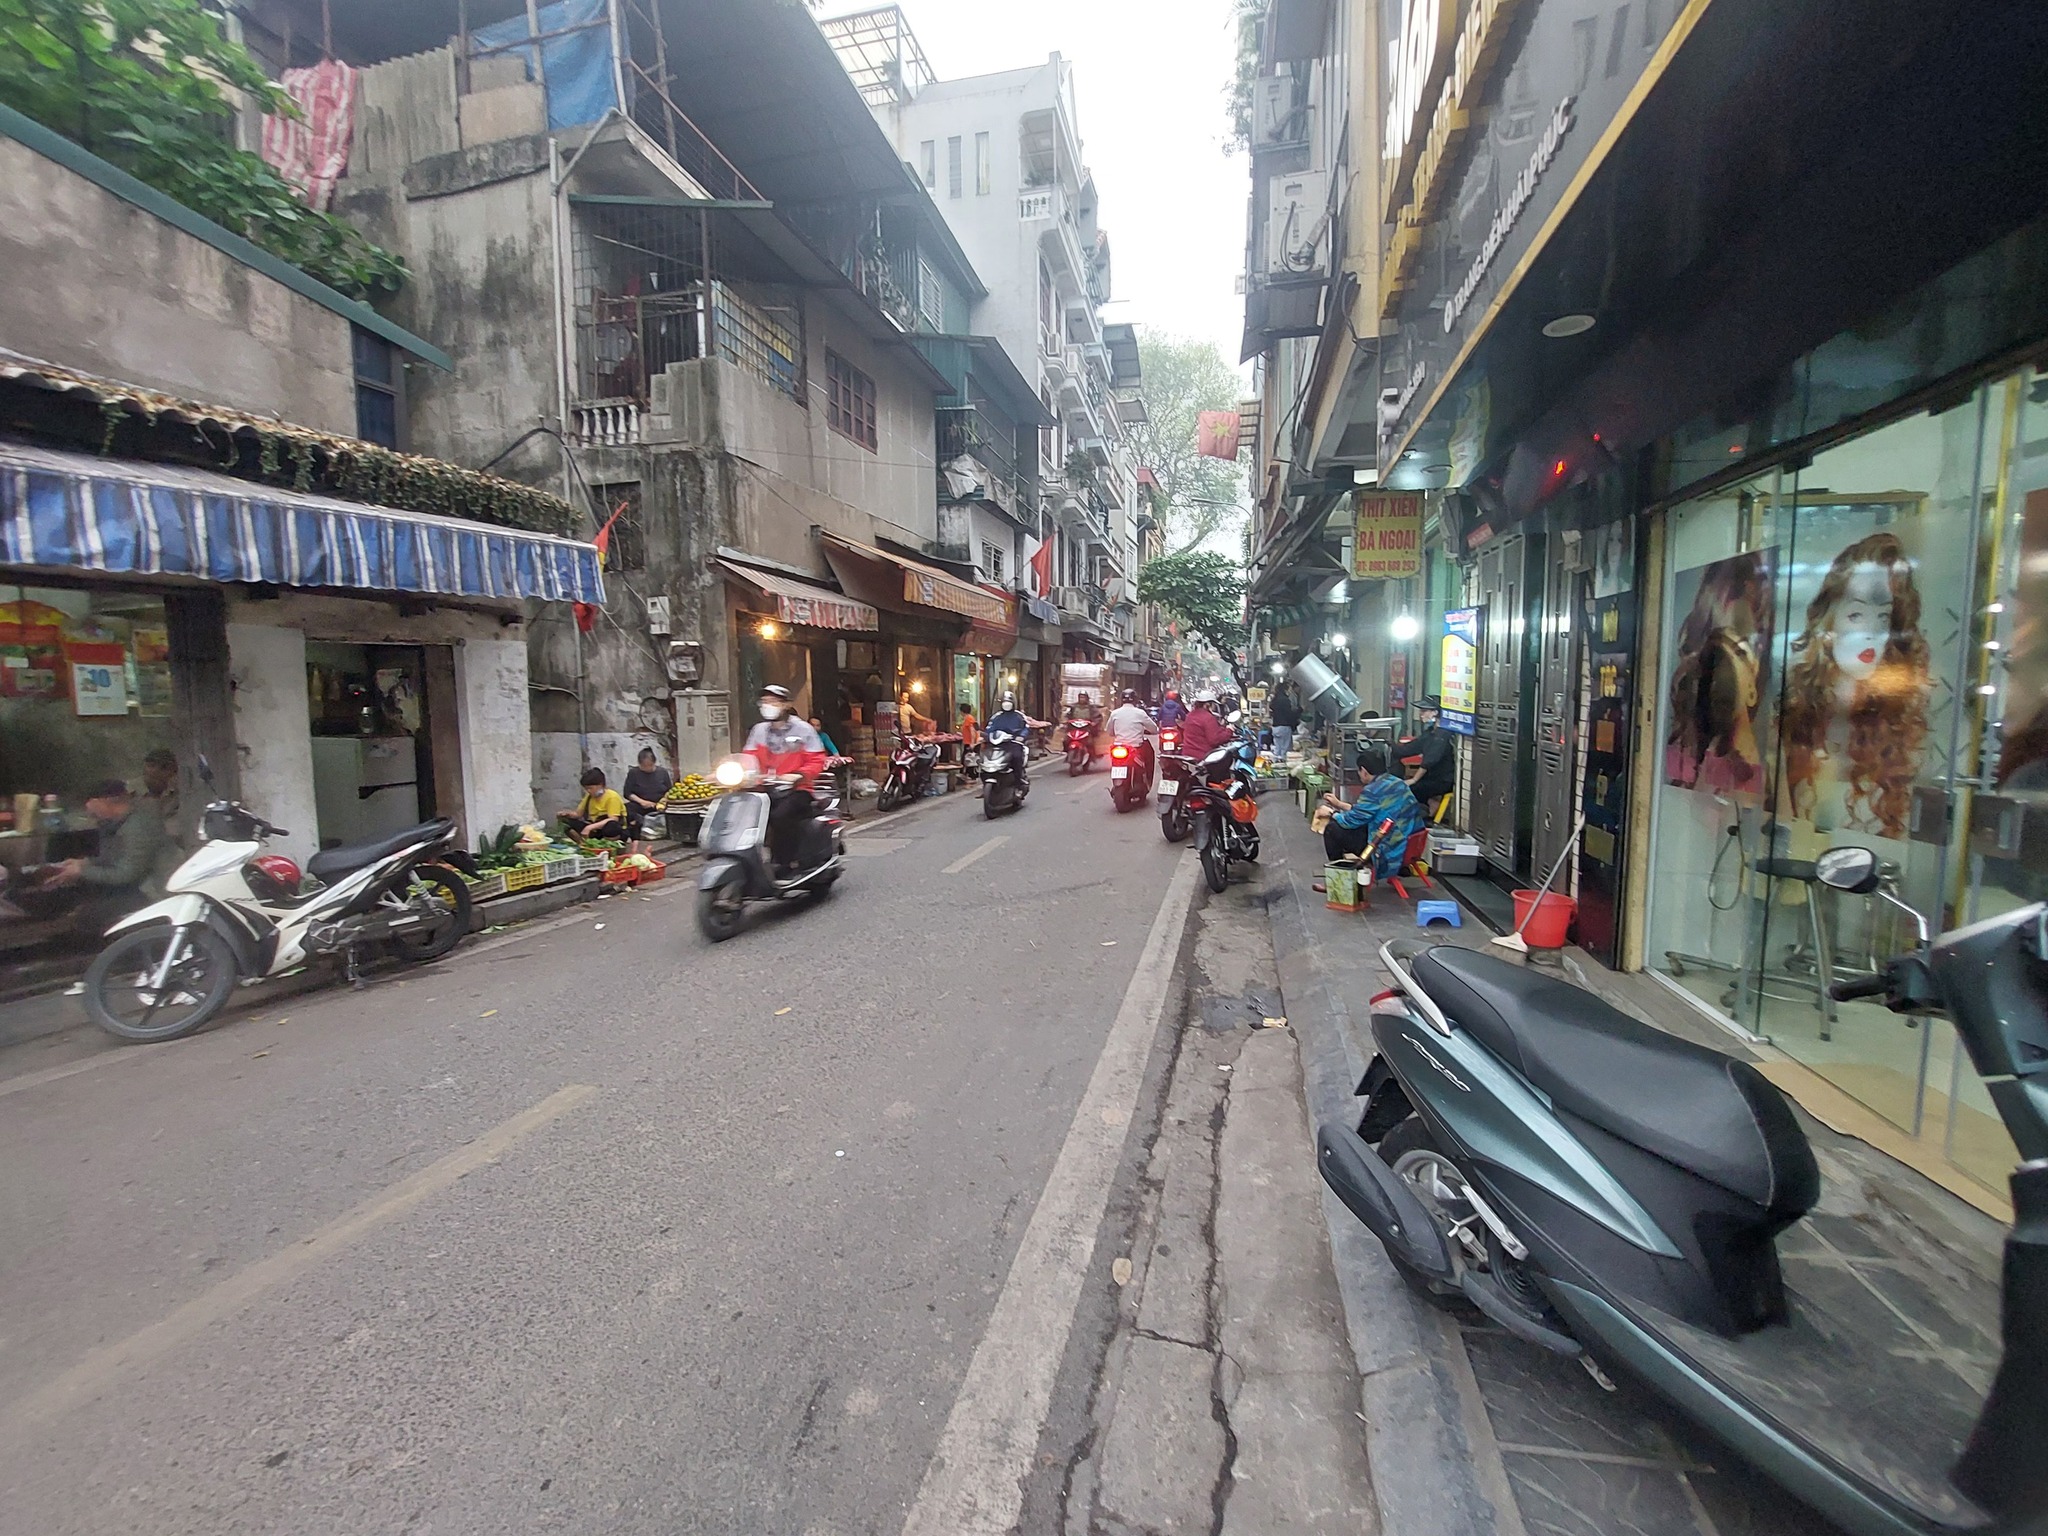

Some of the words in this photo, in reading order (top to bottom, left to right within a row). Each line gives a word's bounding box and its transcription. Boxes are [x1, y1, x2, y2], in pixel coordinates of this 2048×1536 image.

[1455, 255, 1484, 317] TRANG
[1361, 496, 1386, 522] THỊT
[1360, 526, 1375, 550] BÀ
[1378, 528, 1416, 554] NGOẠI
